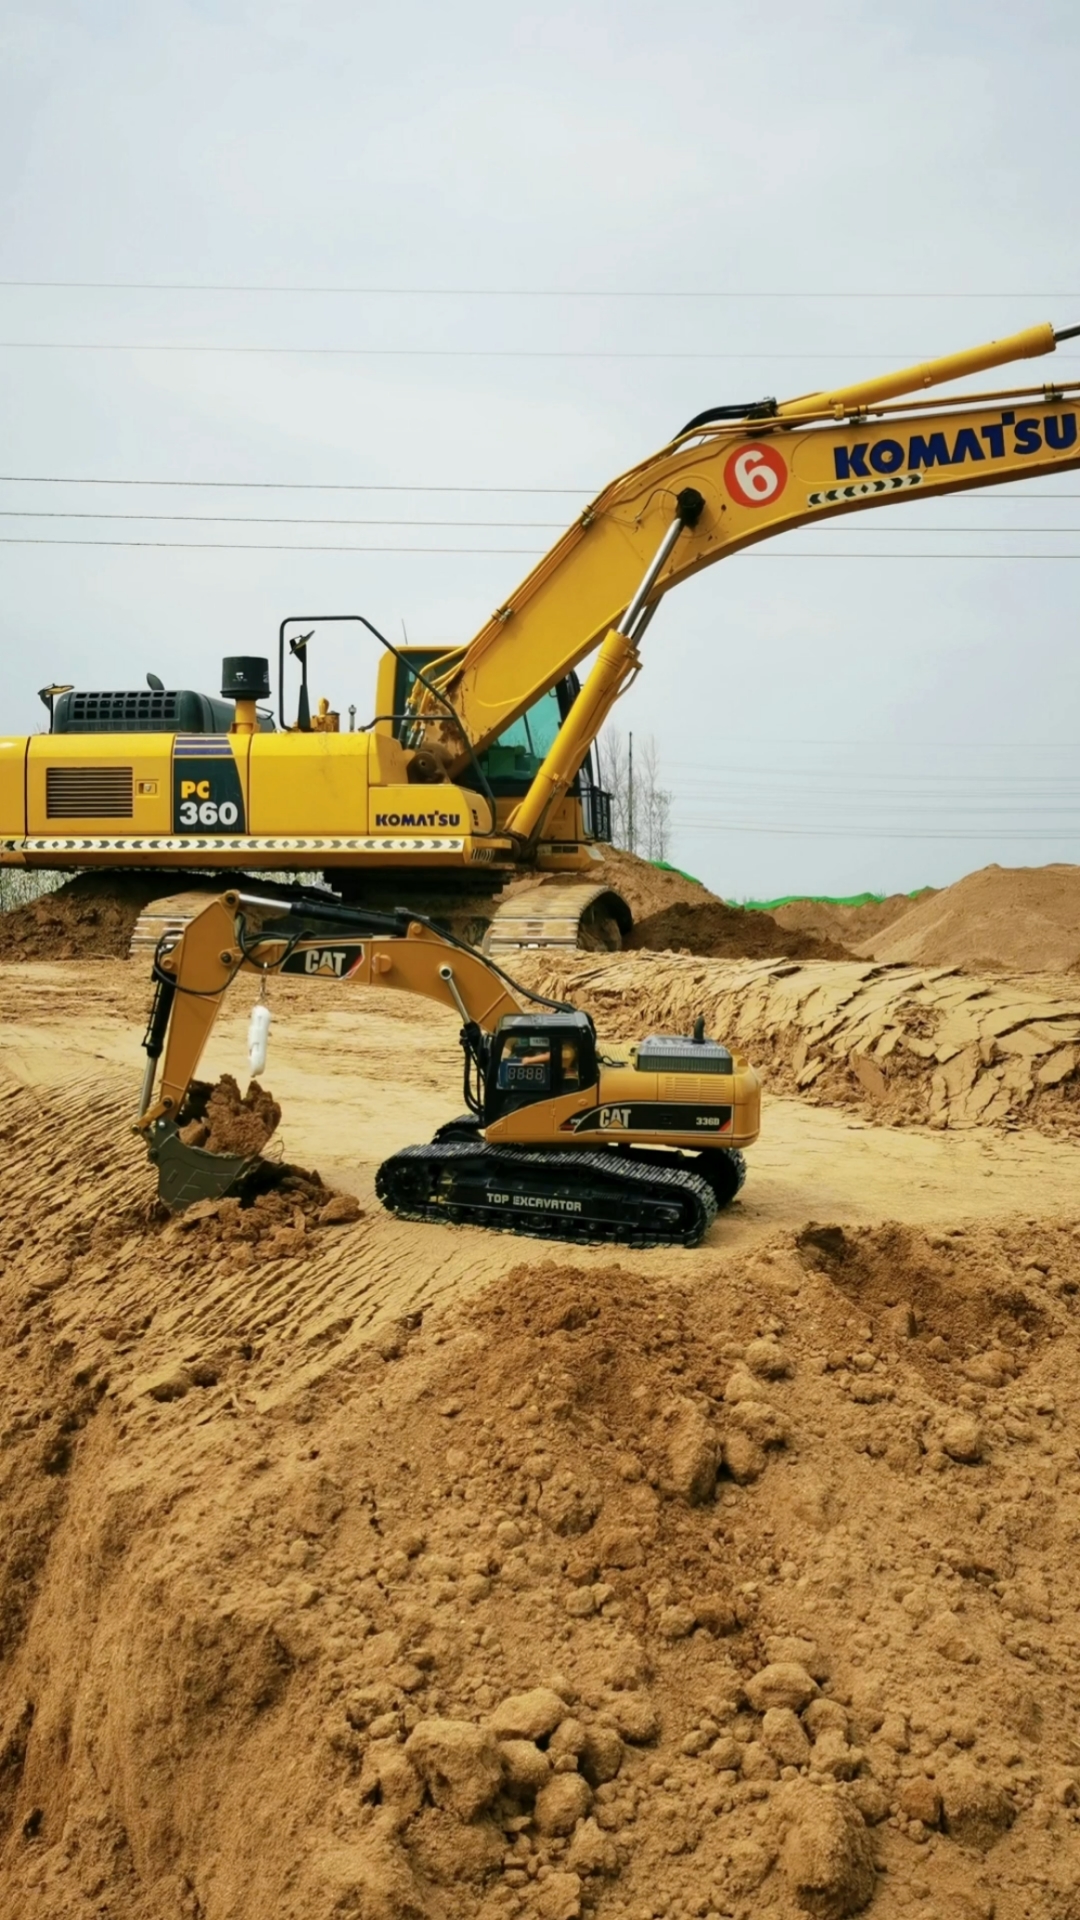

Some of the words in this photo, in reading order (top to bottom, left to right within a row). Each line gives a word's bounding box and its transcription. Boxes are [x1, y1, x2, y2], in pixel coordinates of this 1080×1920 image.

[833, 411, 1078, 480] KOMATSU
[734, 450, 778, 501] 6
[181, 780, 210, 799] PC
[179, 801, 239, 826] 360
[375, 810, 461, 827] KOMATSU
[305, 949, 346, 977] CAT
[600, 1108, 632, 1129] CAT
[487, 1193, 509, 1204] TOP
[513, 1195, 582, 1212] EXCAVATOR
